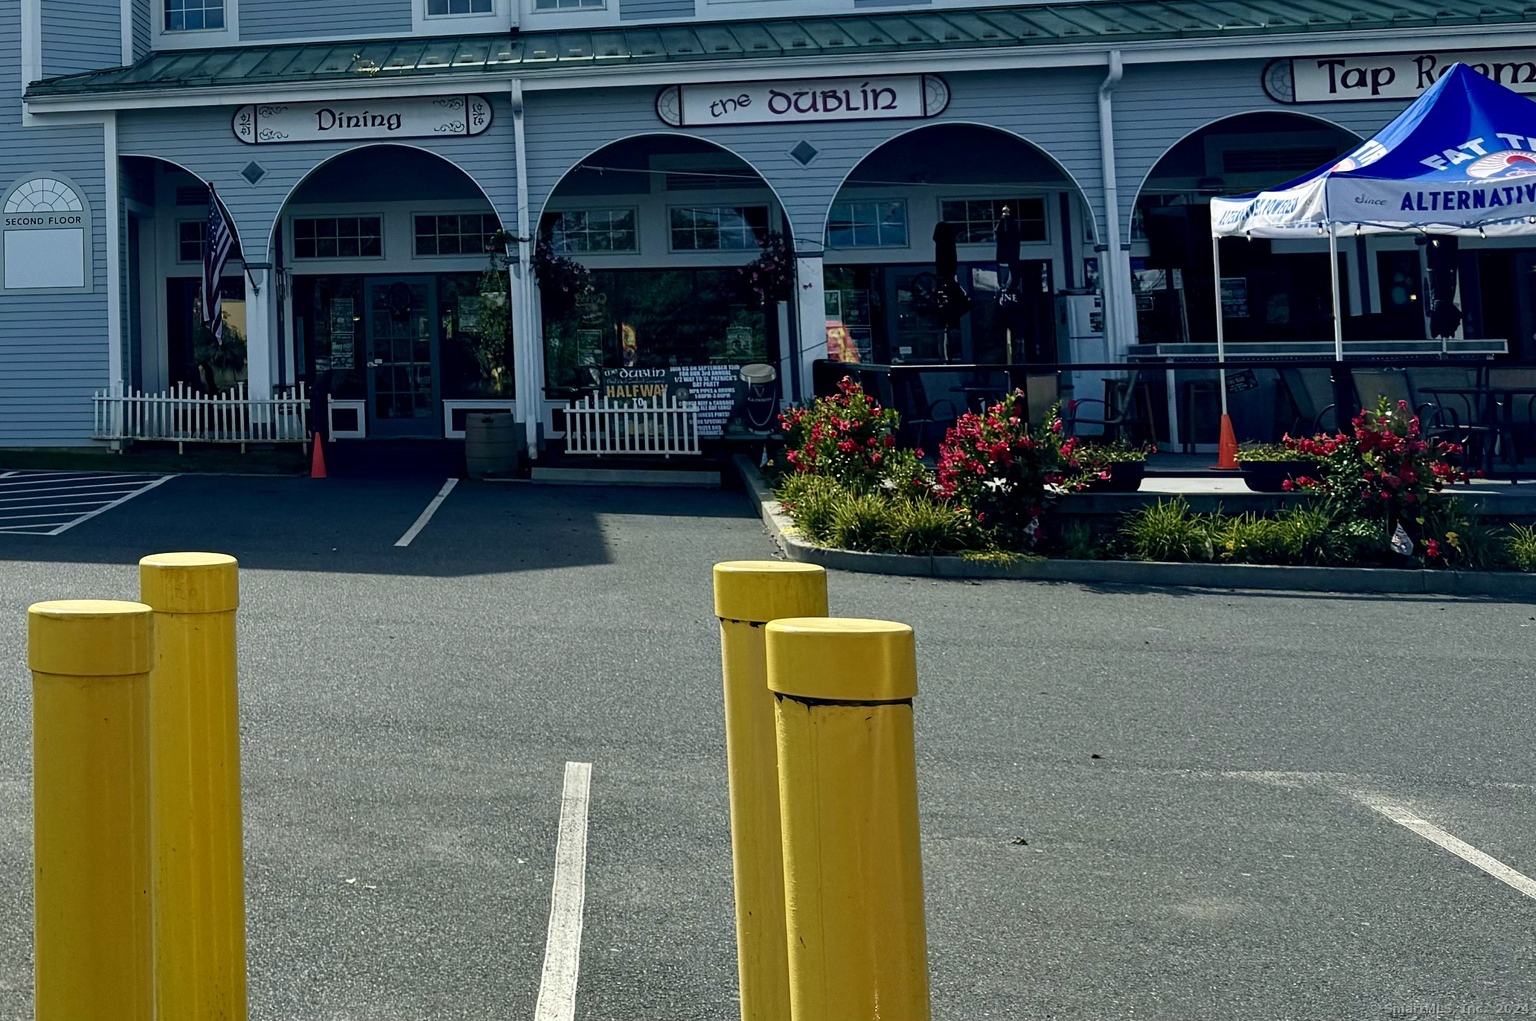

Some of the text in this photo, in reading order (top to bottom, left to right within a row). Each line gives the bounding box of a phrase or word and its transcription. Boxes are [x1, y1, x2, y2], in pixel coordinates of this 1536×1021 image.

[1317, 59, 1396, 95] Tap
[709, 93, 752, 118] the
[315, 108, 402, 131] Dining
[1420, 136, 1490, 171] FAT
[1354, 194, 1388, 206] Since
[5, 216, 82, 226] SECOND FLOOR
[606, 384, 668, 397] HALFWAY
